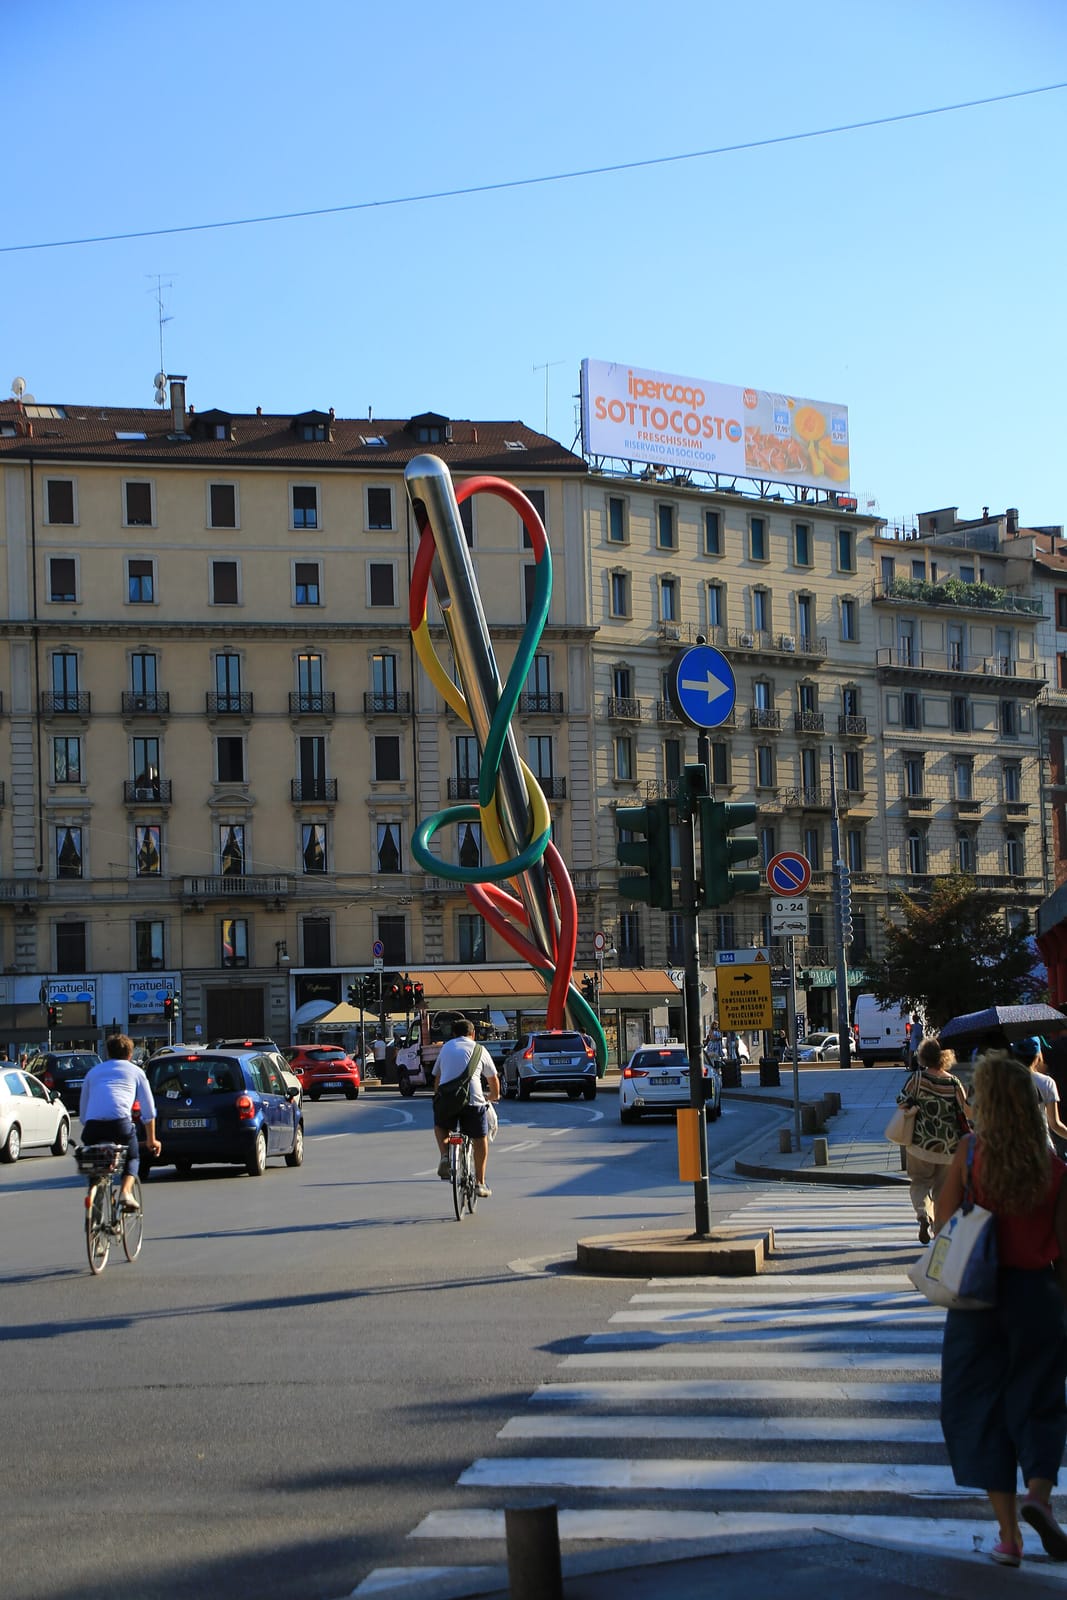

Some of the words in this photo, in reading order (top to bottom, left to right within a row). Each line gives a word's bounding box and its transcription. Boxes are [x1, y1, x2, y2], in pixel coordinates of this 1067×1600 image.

[628, 369, 706, 411] ipercoop
[594, 395, 743, 443] SOTTOCOSTO
[637, 431, 703, 449] FRESCHISSIMI
[624, 439, 666, 455] RISERVATO
[666, 446, 675, 455] AI
[675, 447, 694, 459] SOCI
[694, 450, 717, 462] COOP
[790, 903, 804, 912] 24
[49, 981, 94, 993] matuella
[129, 979, 173, 991] matuella
[728, 1011, 764, 1019] POLICLINICO
